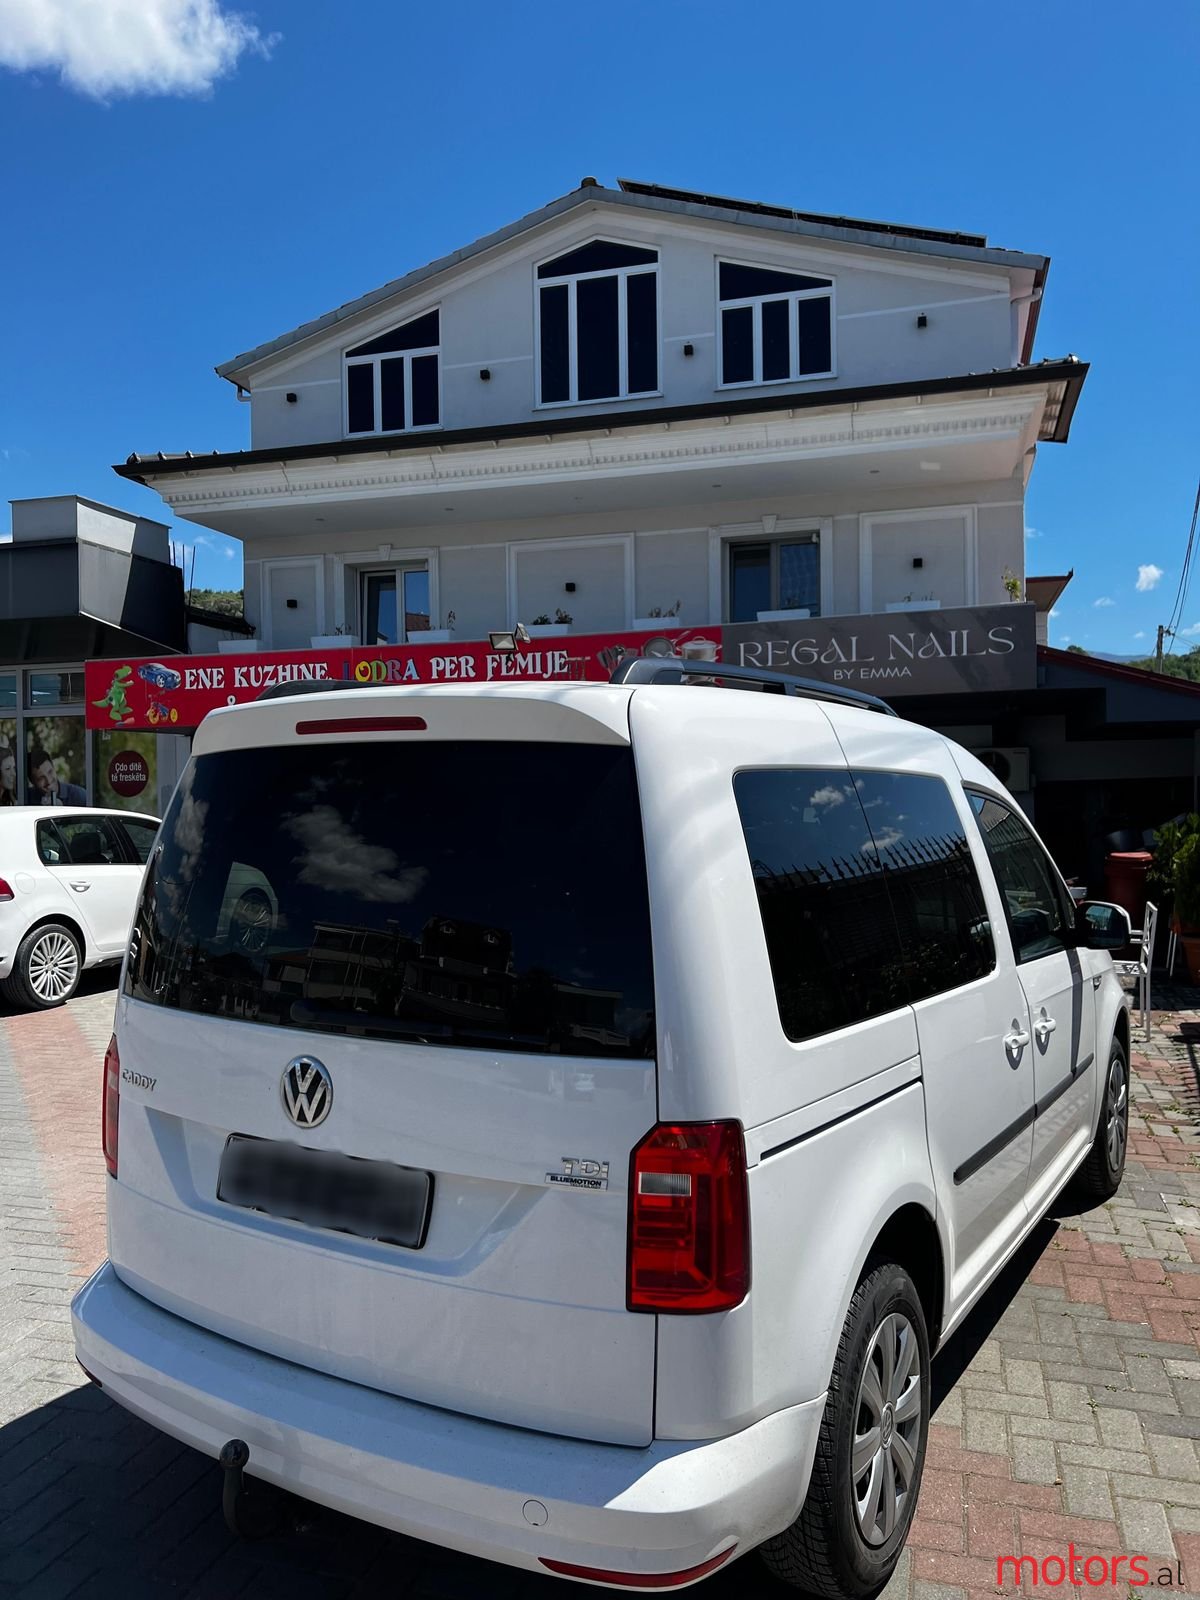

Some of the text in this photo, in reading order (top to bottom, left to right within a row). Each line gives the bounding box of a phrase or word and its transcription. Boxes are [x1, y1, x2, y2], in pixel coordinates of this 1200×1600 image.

[739, 626, 1015, 667] REGAL NAILS
[184, 667, 225, 690] ENE
[429, 656, 477, 680] PER
[486, 650, 569, 682] FEMIJE
[833, 666, 912, 681] BY EMMA
[114, 762, 128, 773] Çdo
[122, 1068, 157, 1092] CADDY
[550, 1175, 602, 1187] BLUEMOTION
